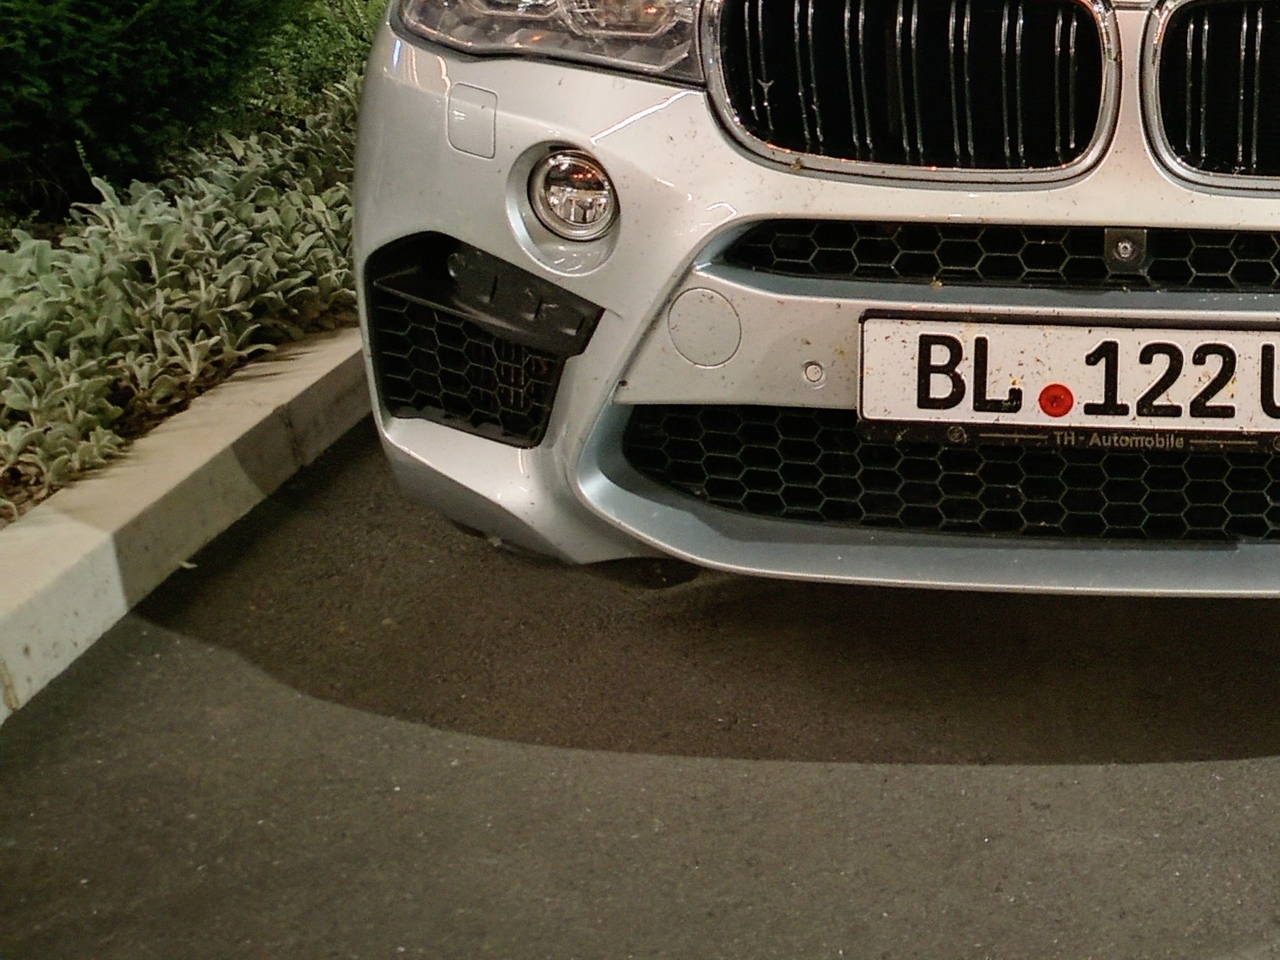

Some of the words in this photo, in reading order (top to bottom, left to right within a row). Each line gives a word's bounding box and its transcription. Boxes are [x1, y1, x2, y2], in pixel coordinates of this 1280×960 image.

[916, 333, 1023, 414] BL
[1083, 340, 1238, 418] 122
[1089, 432, 1184, 448] Automobile
